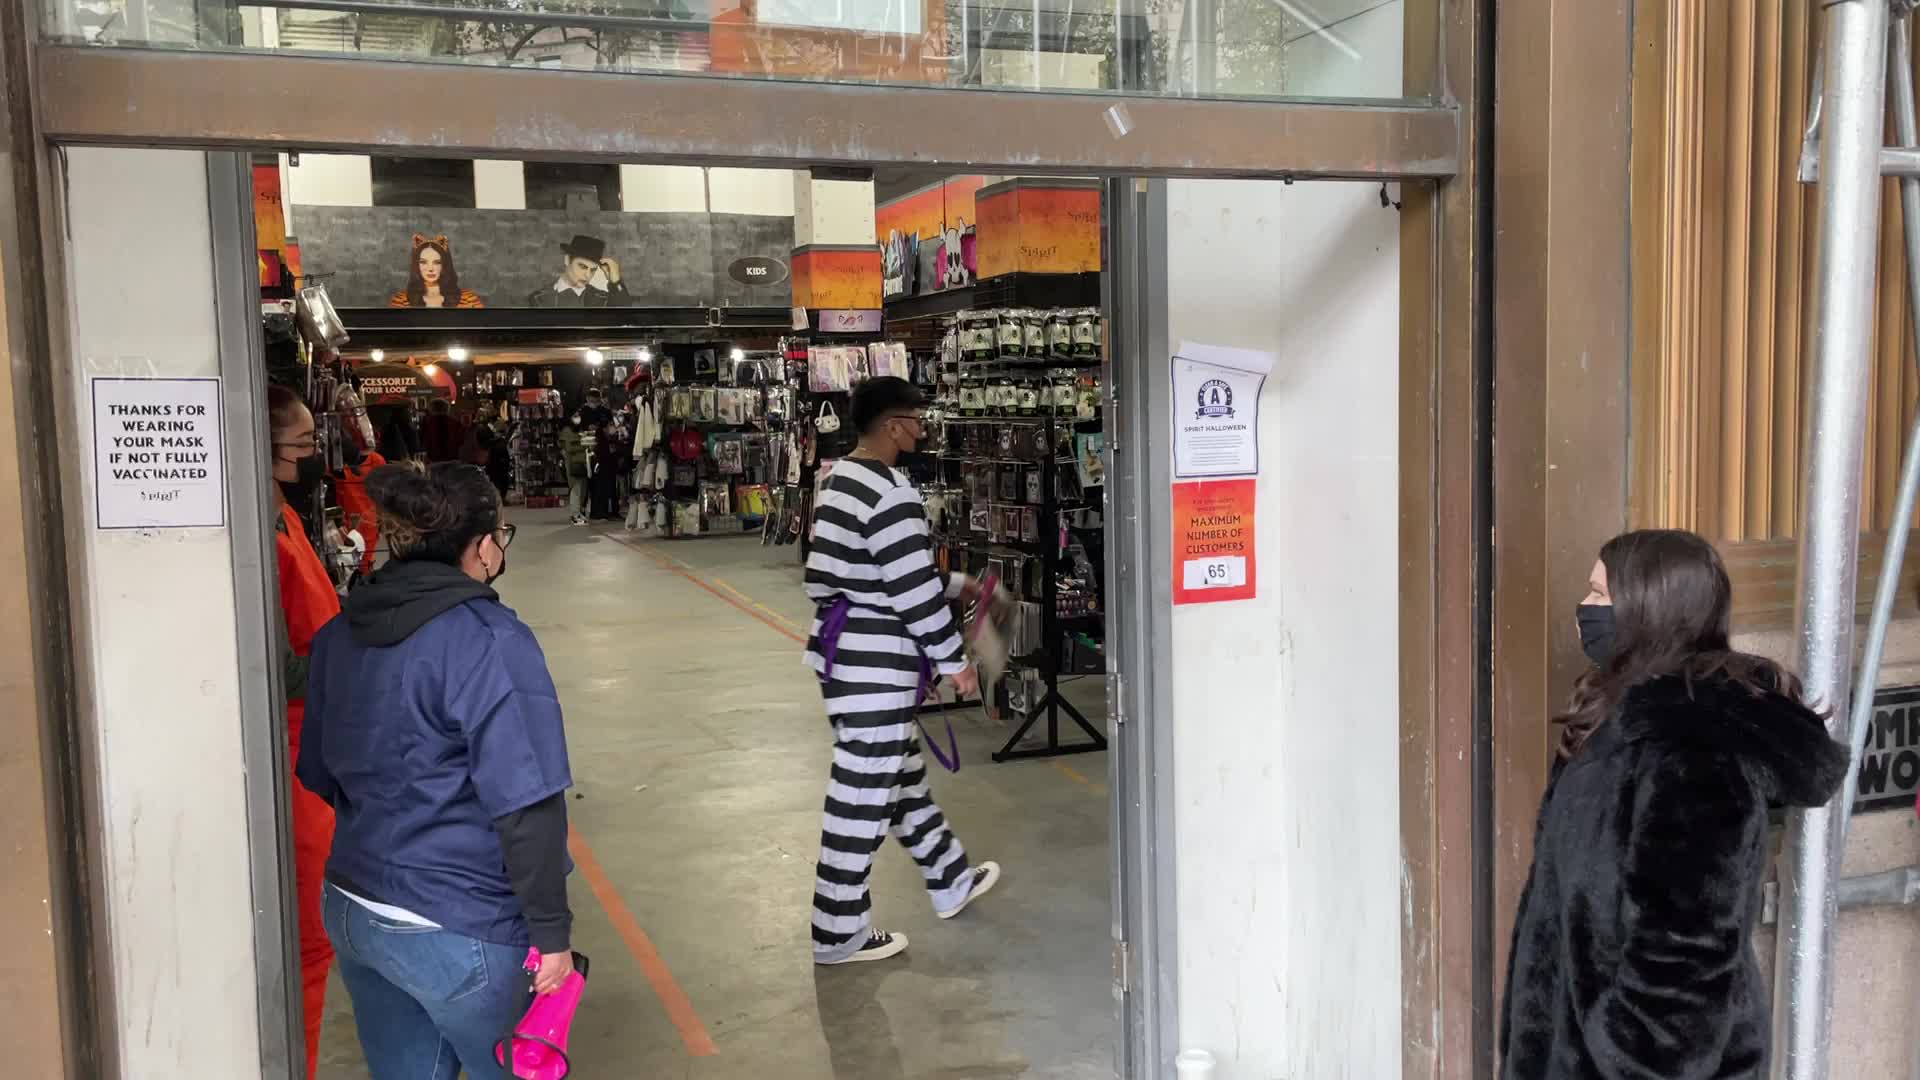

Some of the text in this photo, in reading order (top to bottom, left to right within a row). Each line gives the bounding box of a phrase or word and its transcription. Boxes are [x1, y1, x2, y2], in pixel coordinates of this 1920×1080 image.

[746, 267, 767, 275] KIDS
[385, 386, 407, 394] LOOK
[1211, 388, 1220, 404] A
[108, 405, 206, 416] THANKS FOR
[122, 421, 194, 432] WEARING
[113, 437, 204, 448] YOUR MASK
[109, 452, 208, 464] IF NOT FULLY
[113, 468, 207, 480] VACCINATED
[1190, 515, 1241, 528] MAXIMUM
[1187, 528, 1243, 541] NUMBER OF
[1186, 542, 1244, 554] CUSTOMERS
[1207, 564, 1226, 578] 65
